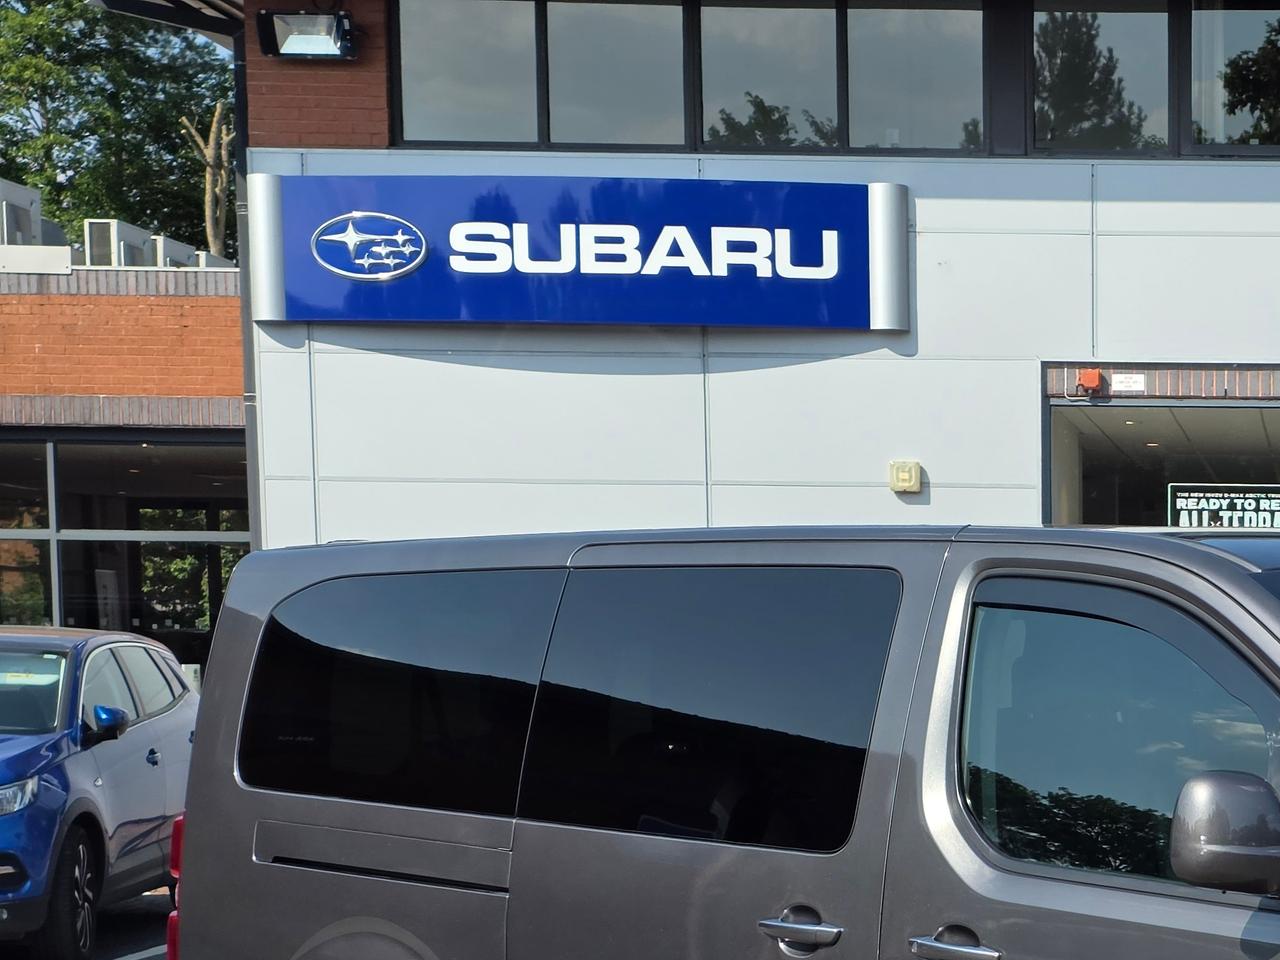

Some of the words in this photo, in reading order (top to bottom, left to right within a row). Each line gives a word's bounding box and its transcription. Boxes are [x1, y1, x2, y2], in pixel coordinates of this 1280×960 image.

[448, 221, 839, 280] SUBARU
[1176, 498, 1231, 510] READY
[1233, 499, 1256, 511] TO
